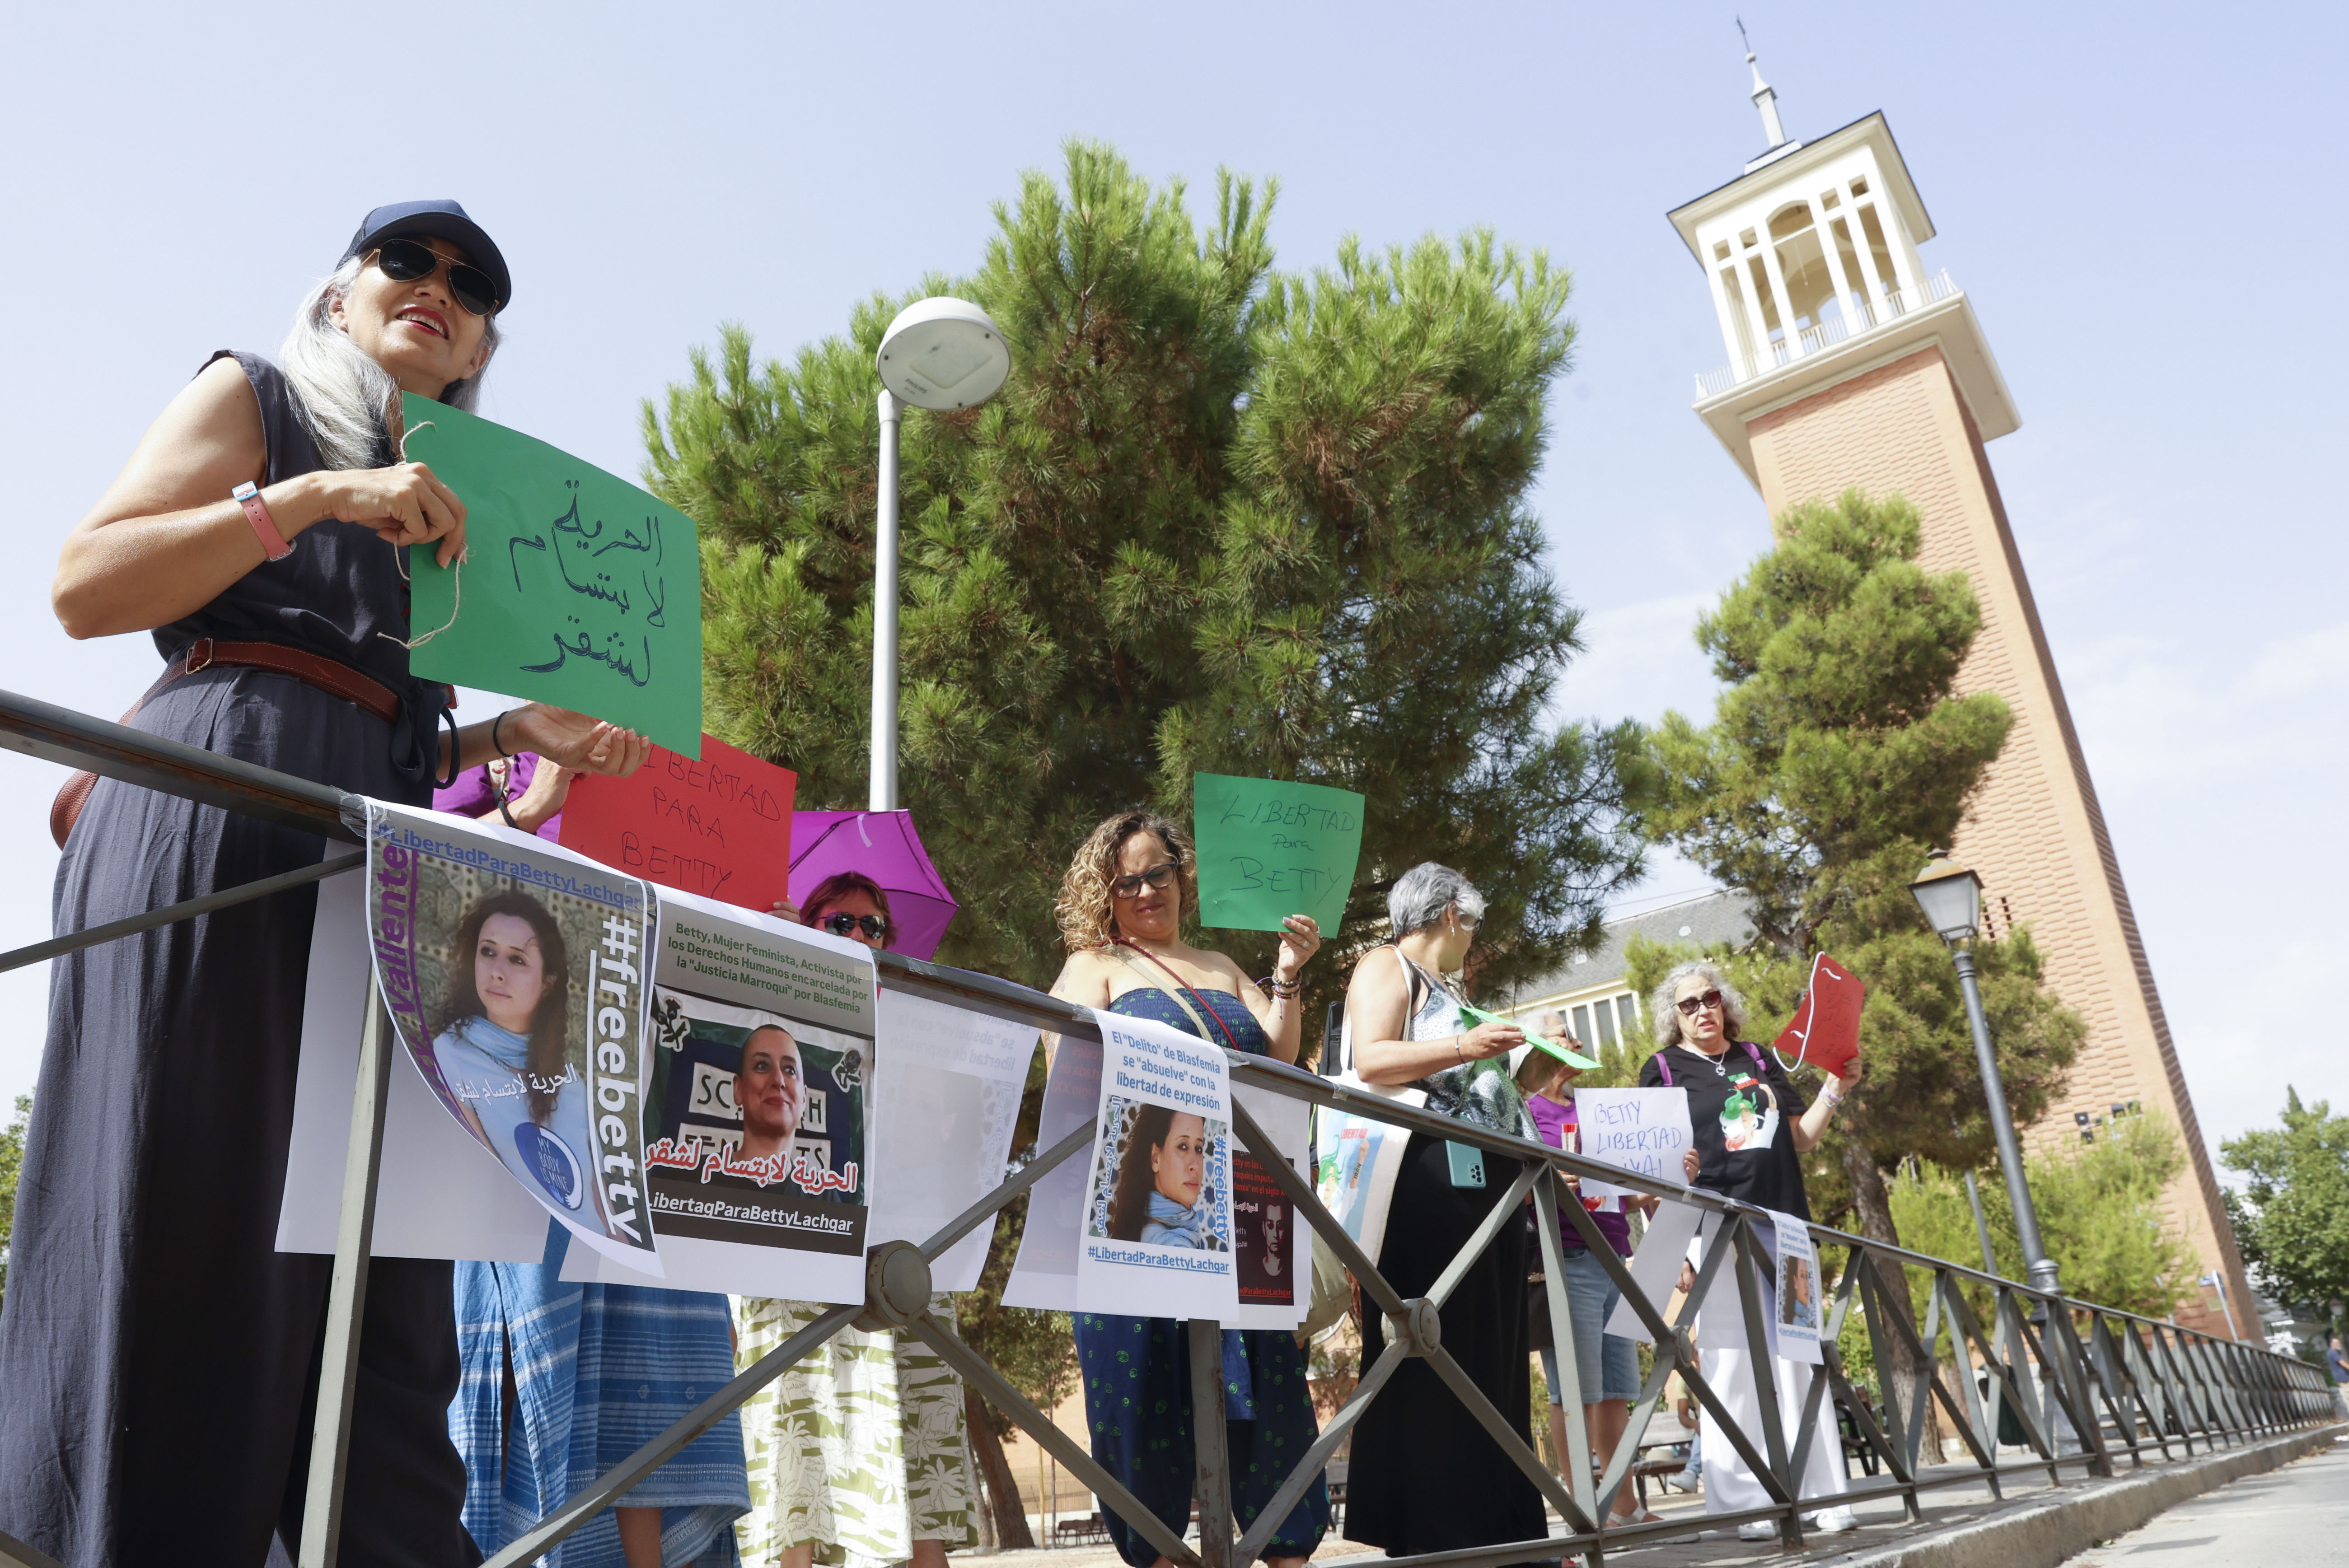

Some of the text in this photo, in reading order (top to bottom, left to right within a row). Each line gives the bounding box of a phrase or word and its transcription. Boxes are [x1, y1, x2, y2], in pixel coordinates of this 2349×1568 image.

[644, 744, 780, 821] IBERTAD
[654, 786, 725, 849] PARA
[1221, 794, 1355, 831] LIBERTAD
[622, 831, 732, 899] BETTY
[1230, 857, 1342, 905] BETTY
[668, 937, 685, 951] los
[687, 942, 739, 966] Derechos
[742, 957, 789, 980] Humanos
[791, 973, 851, 996] encarcelada
[852, 990, 868, 1001] por
[676, 922, 862, 985] Betty, Mujer Feminista, Activista por
[677, 955, 687, 968] la
[689, 959, 738, 981] "Justicia
[794, 989, 811, 1000] por
[813, 992, 860, 1013] Blasfemia
[1111, 1030, 1221, 1074] El "Delito" de Blasfemia
[529, 1062, 578, 1095] الحرية
[597, 915, 642, 1243] #freebetty
[1117, 1071, 1220, 1111] libertad de expresión
[1123, 1055, 1216, 1091] se "absuelve" con la
[1595, 1100, 1641, 1125] BETTY
[537, 1136, 551, 1154] MY
[645, 1138, 703, 1171] لشقر
[1596, 1126, 1682, 1155] LIBERTAD
[538, 1151, 560, 1174] BODY
[540, 1167, 571, 1194] IS MINE
[791, 1156, 858, 1195] الحرية
[1213, 1135, 1228, 1243] #freebetty
[1088, 1246, 1230, 1274] #LibertadParaBettyLachgar
[1239, 1287, 1291, 1297] adParaBettyLachgar
